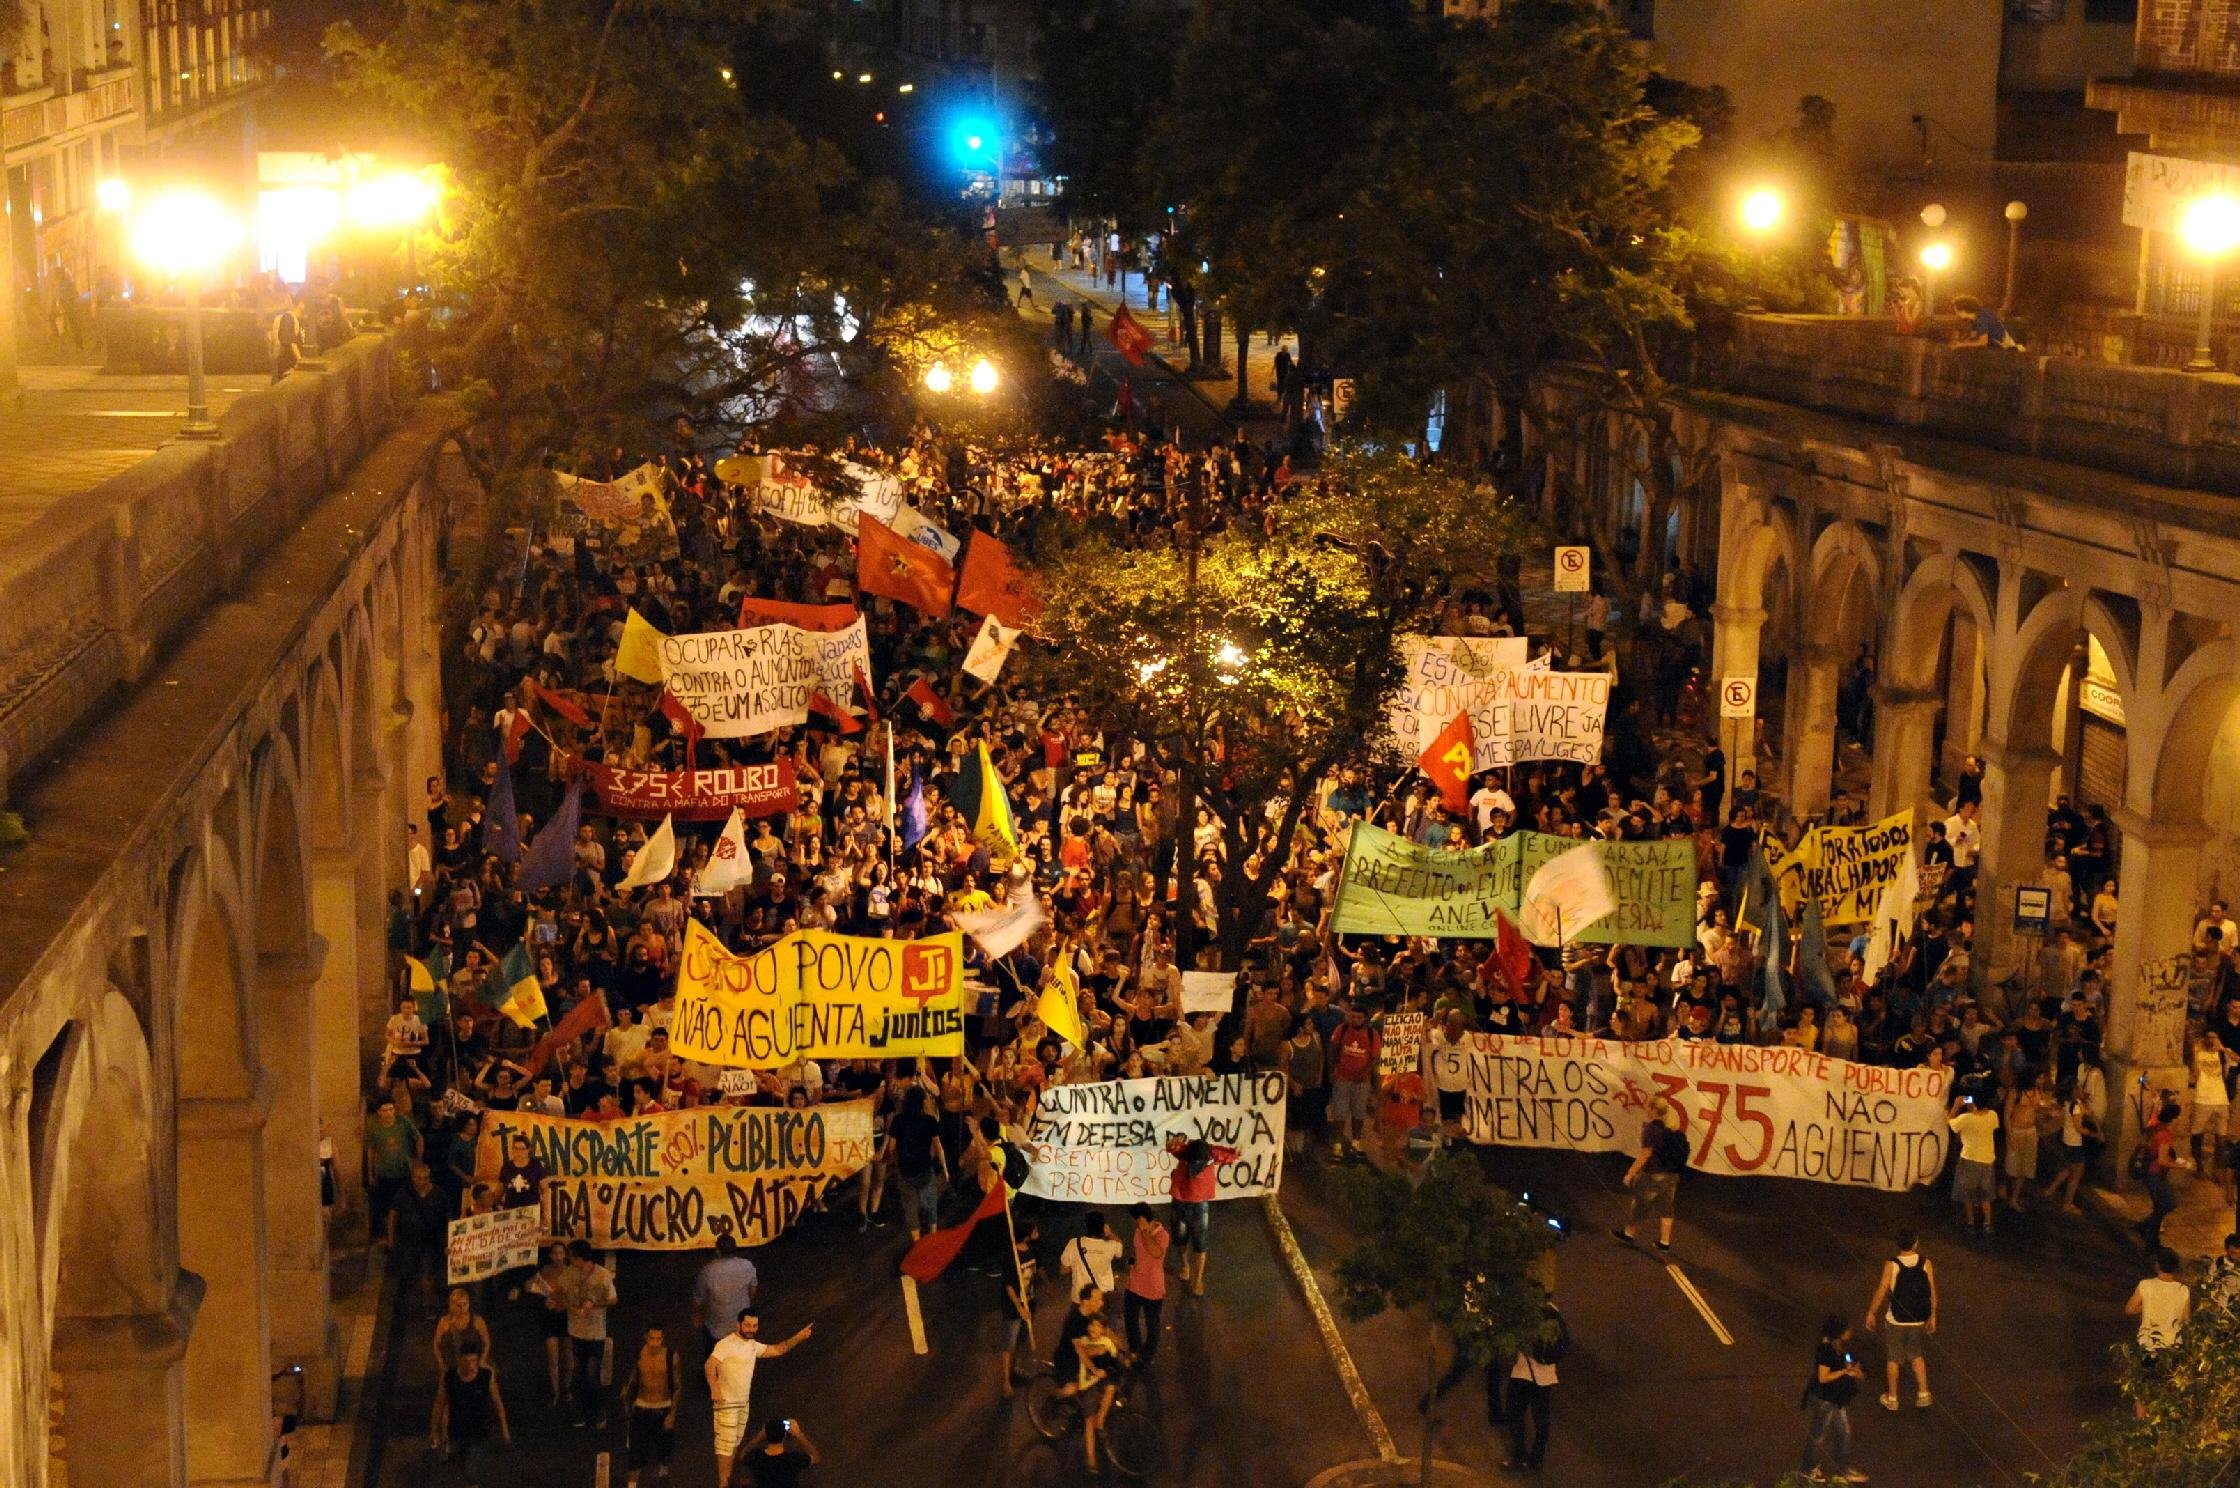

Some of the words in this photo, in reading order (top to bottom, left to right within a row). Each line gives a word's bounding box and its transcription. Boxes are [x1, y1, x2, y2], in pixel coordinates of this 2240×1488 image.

[664, 633, 744, 665] OCUPAR
[760, 628, 803, 656] RUAS
[670, 671, 732, 693] CONTRA
[735, 668, 746, 687] O
[1420, 679, 1497, 716] CONTRA
[1505, 671, 1608, 704] AUMENTO
[725, 692, 749, 719] UM
[1513, 702, 1579, 738] LIVRE
[1582, 711, 1602, 733] JÁ
[694, 764, 778, 797] ROUBO
[610, 794, 659, 809] CONTRA
[663, 799, 672, 809] A
[712, 796, 729, 807] DO
[1820, 828, 1862, 866] FORA
[1853, 824, 1910, 856] TODOS
[792, 940, 893, 993] POVO
[674, 997, 722, 1051] NÃO
[731, 1002, 865, 1060] AGUENTA
[869, 1007, 963, 1047] juntos
[1539, 1037, 1609, 1059] LUTA
[1682, 1044, 1832, 1080] TRANSPORTE
[1153, 1071, 1285, 1112] AUMENTO
[1564, 1060, 1608, 1095] OS
[1826, 1090, 1897, 1124] NÃO
[491, 1121, 660, 1177] TANSPORTE
[708, 1109, 825, 1173] PÚBLICO
[1077, 1120, 1157, 1147] DEFESA
[1194, 1116, 1242, 1145] VOU
[1145, 1150, 1172, 1171] DO
[1772, 1119, 1942, 1188] AGUENTO
[611, 1182, 704, 1243] LUCRO
